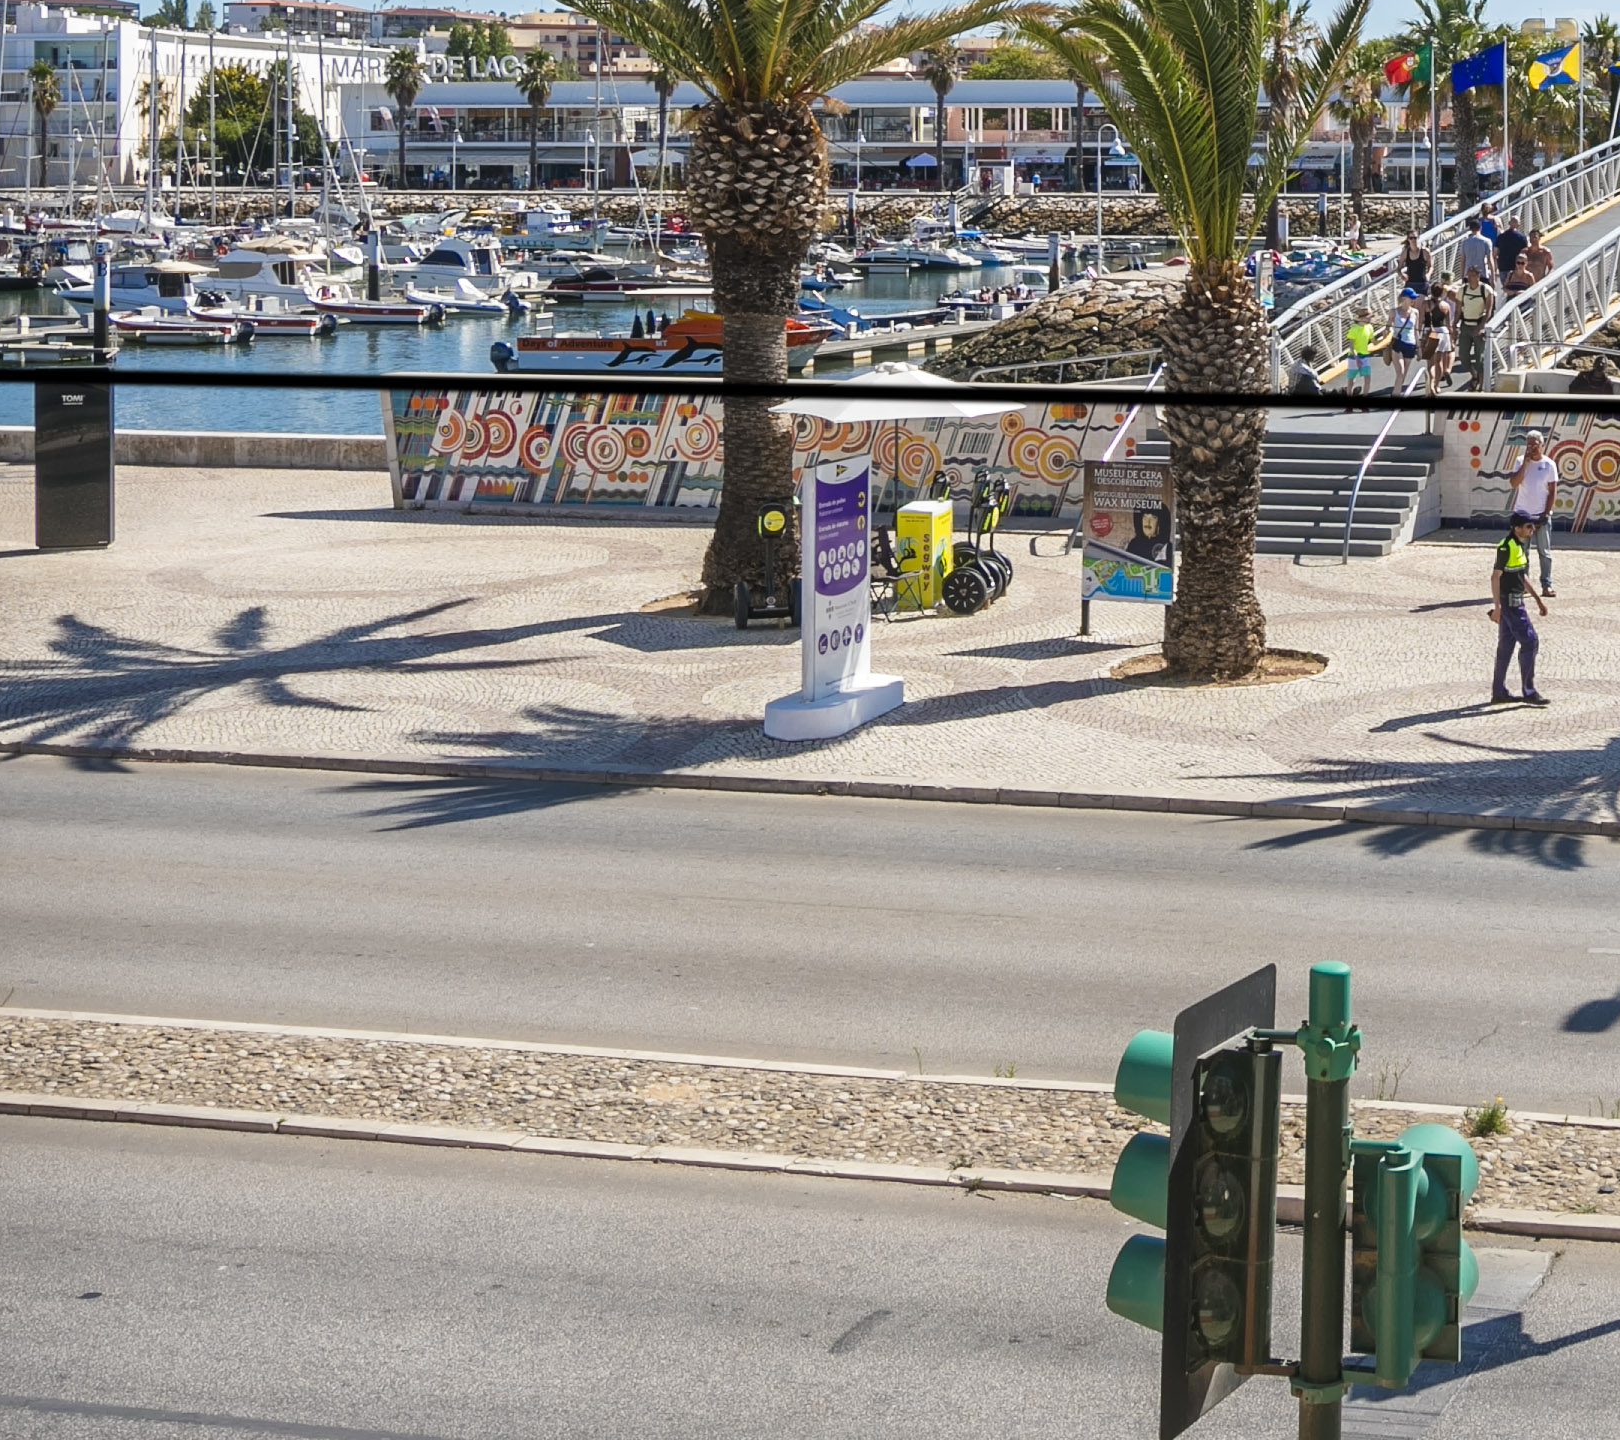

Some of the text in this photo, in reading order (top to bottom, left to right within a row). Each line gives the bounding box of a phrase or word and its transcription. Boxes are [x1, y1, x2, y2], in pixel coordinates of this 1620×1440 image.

[430, 56, 465, 77] DE
[522, 339, 614, 349] Days of Adventure
[61, 394, 84, 402] TOMI
[1094, 468, 1163, 479] MUSEU DE CERA
[1097, 477, 1163, 488] DESCOBRIMENTOS
[1093, 498, 1162, 510] WAX MUSEUM
[922, 533, 931, 591] Segway
